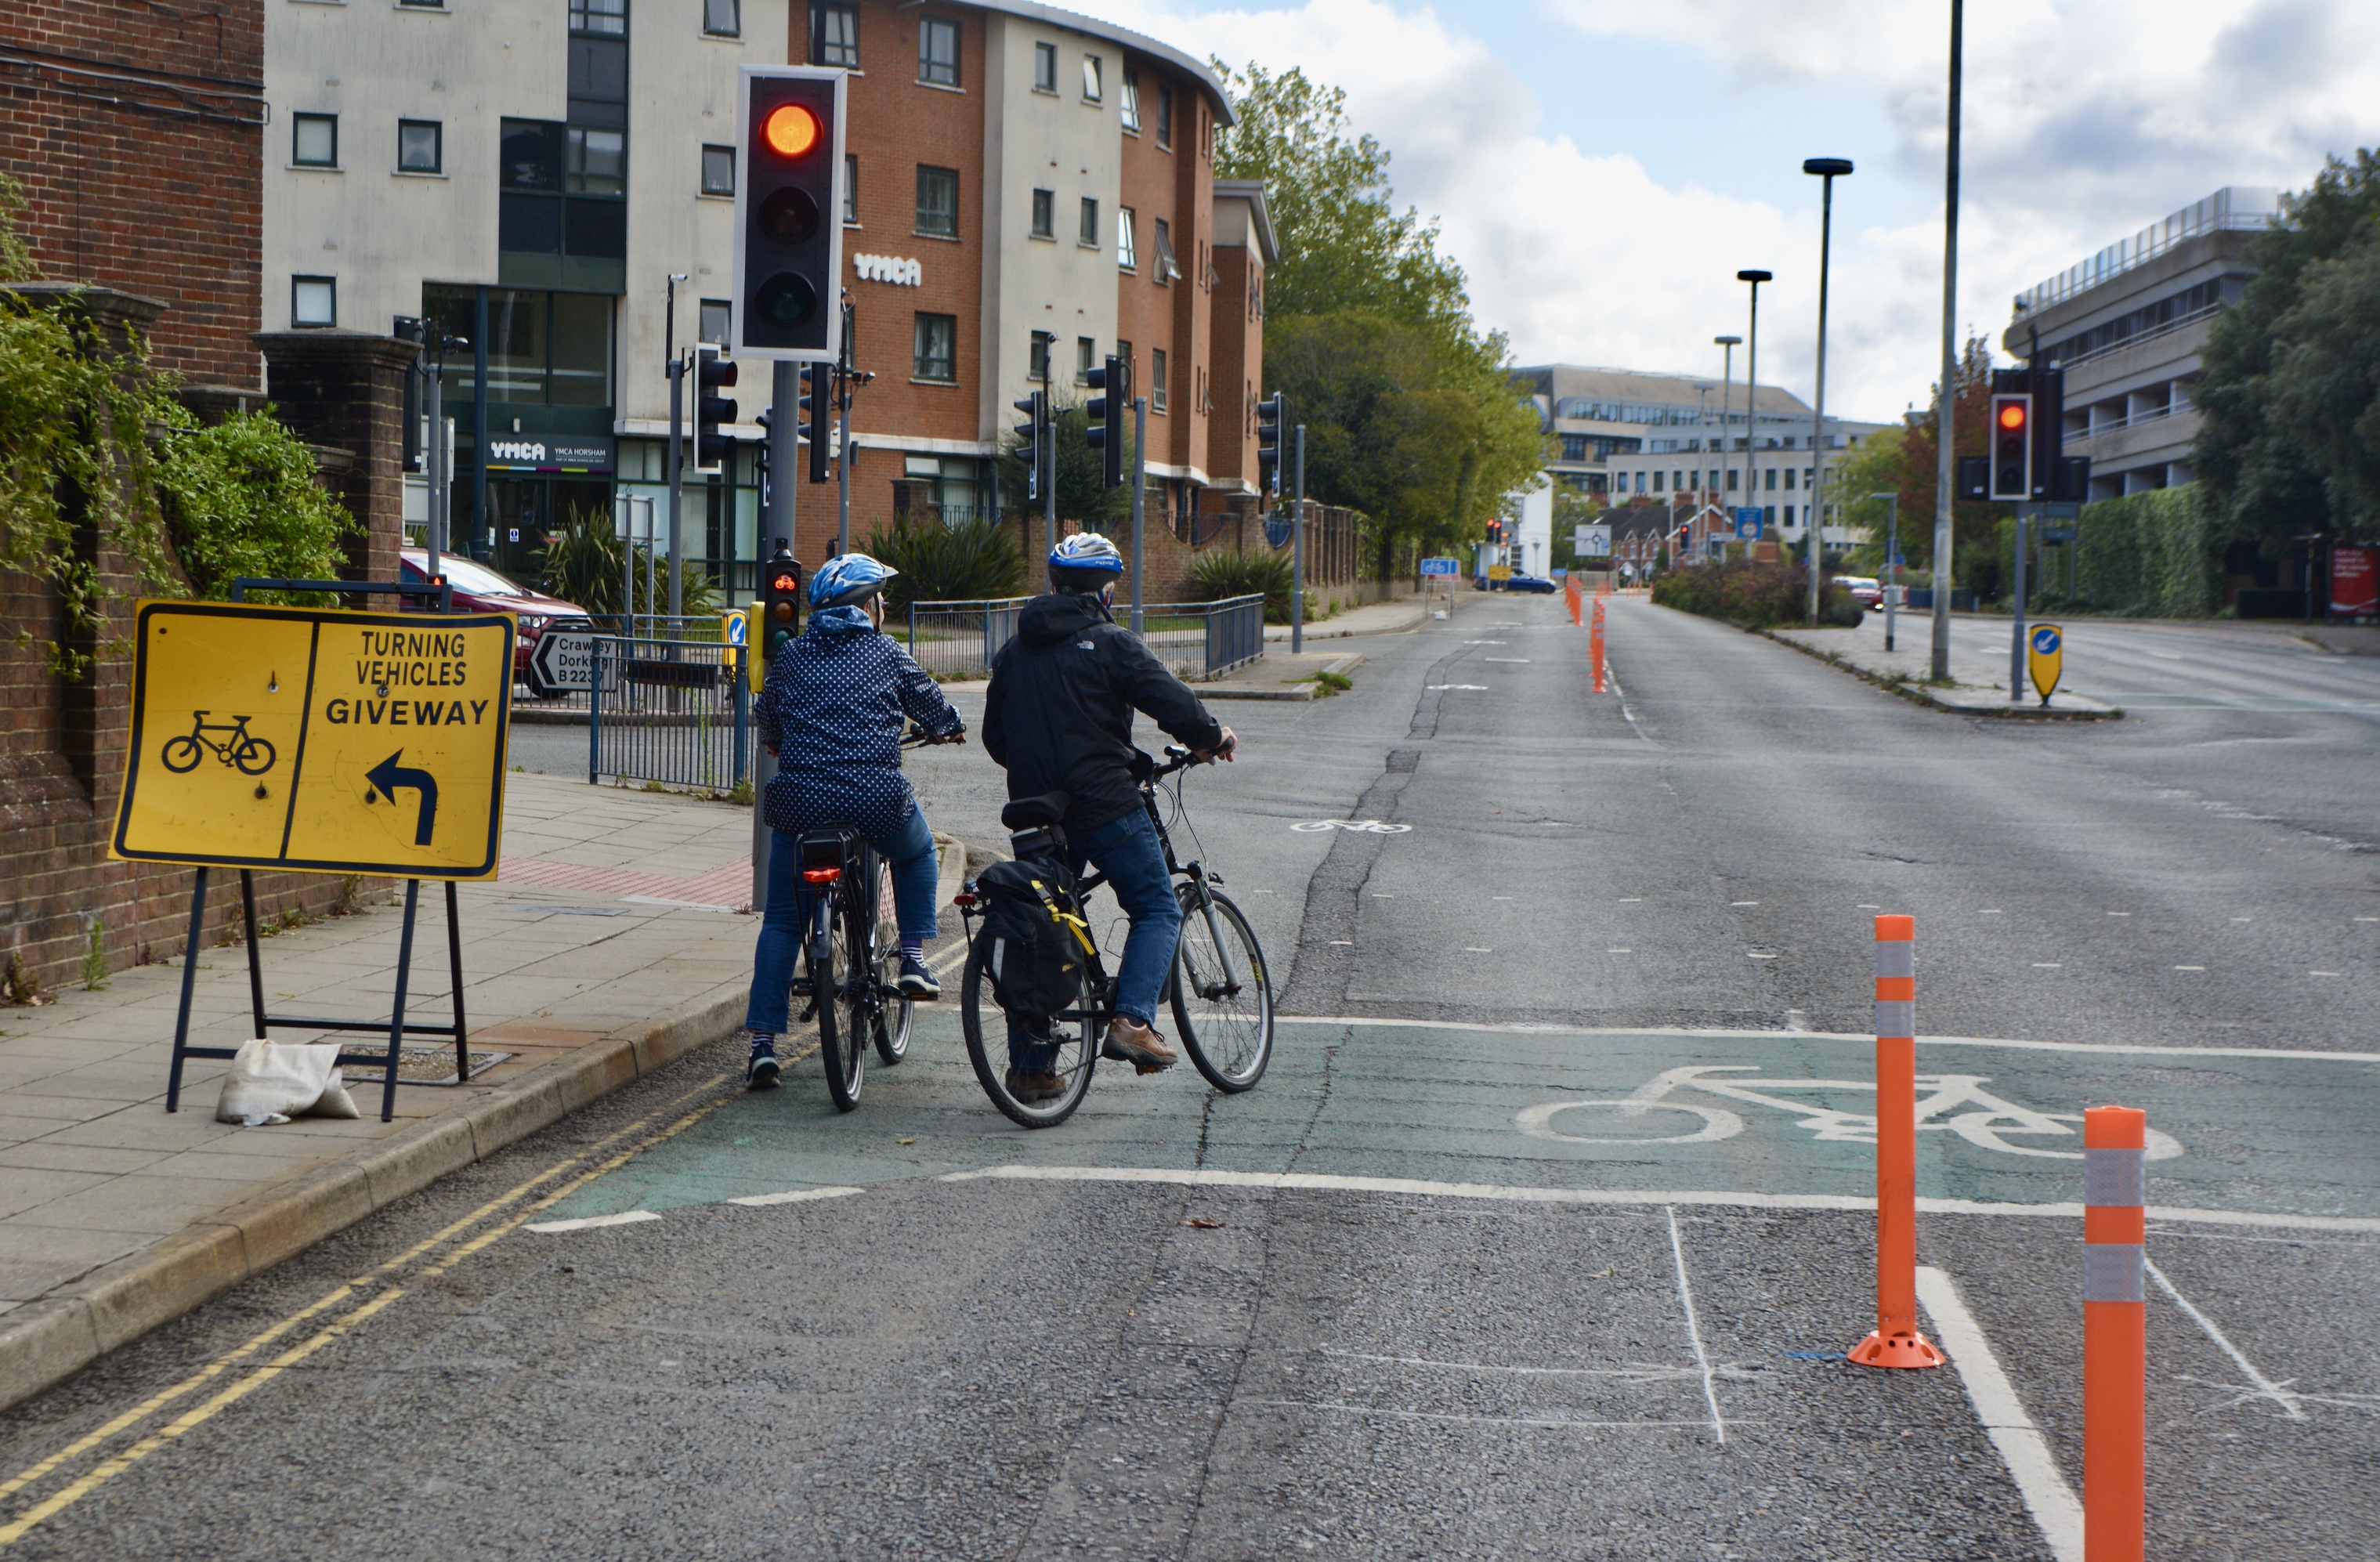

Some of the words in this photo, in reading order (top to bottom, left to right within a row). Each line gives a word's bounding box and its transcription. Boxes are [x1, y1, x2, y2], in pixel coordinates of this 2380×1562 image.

[853, 252, 921, 287] YMCA
[490, 441, 545, 461] YMCA
[573, 448, 606, 457] HORSHAM
[361, 631, 465, 657] TURNING
[559, 638, 611, 653] Crawey
[559, 654, 608, 669] Dorkig
[356, 660, 467, 686] VEHICLES
[559, 670, 567, 682] B
[326, 698, 489, 725] GIVEWAY
